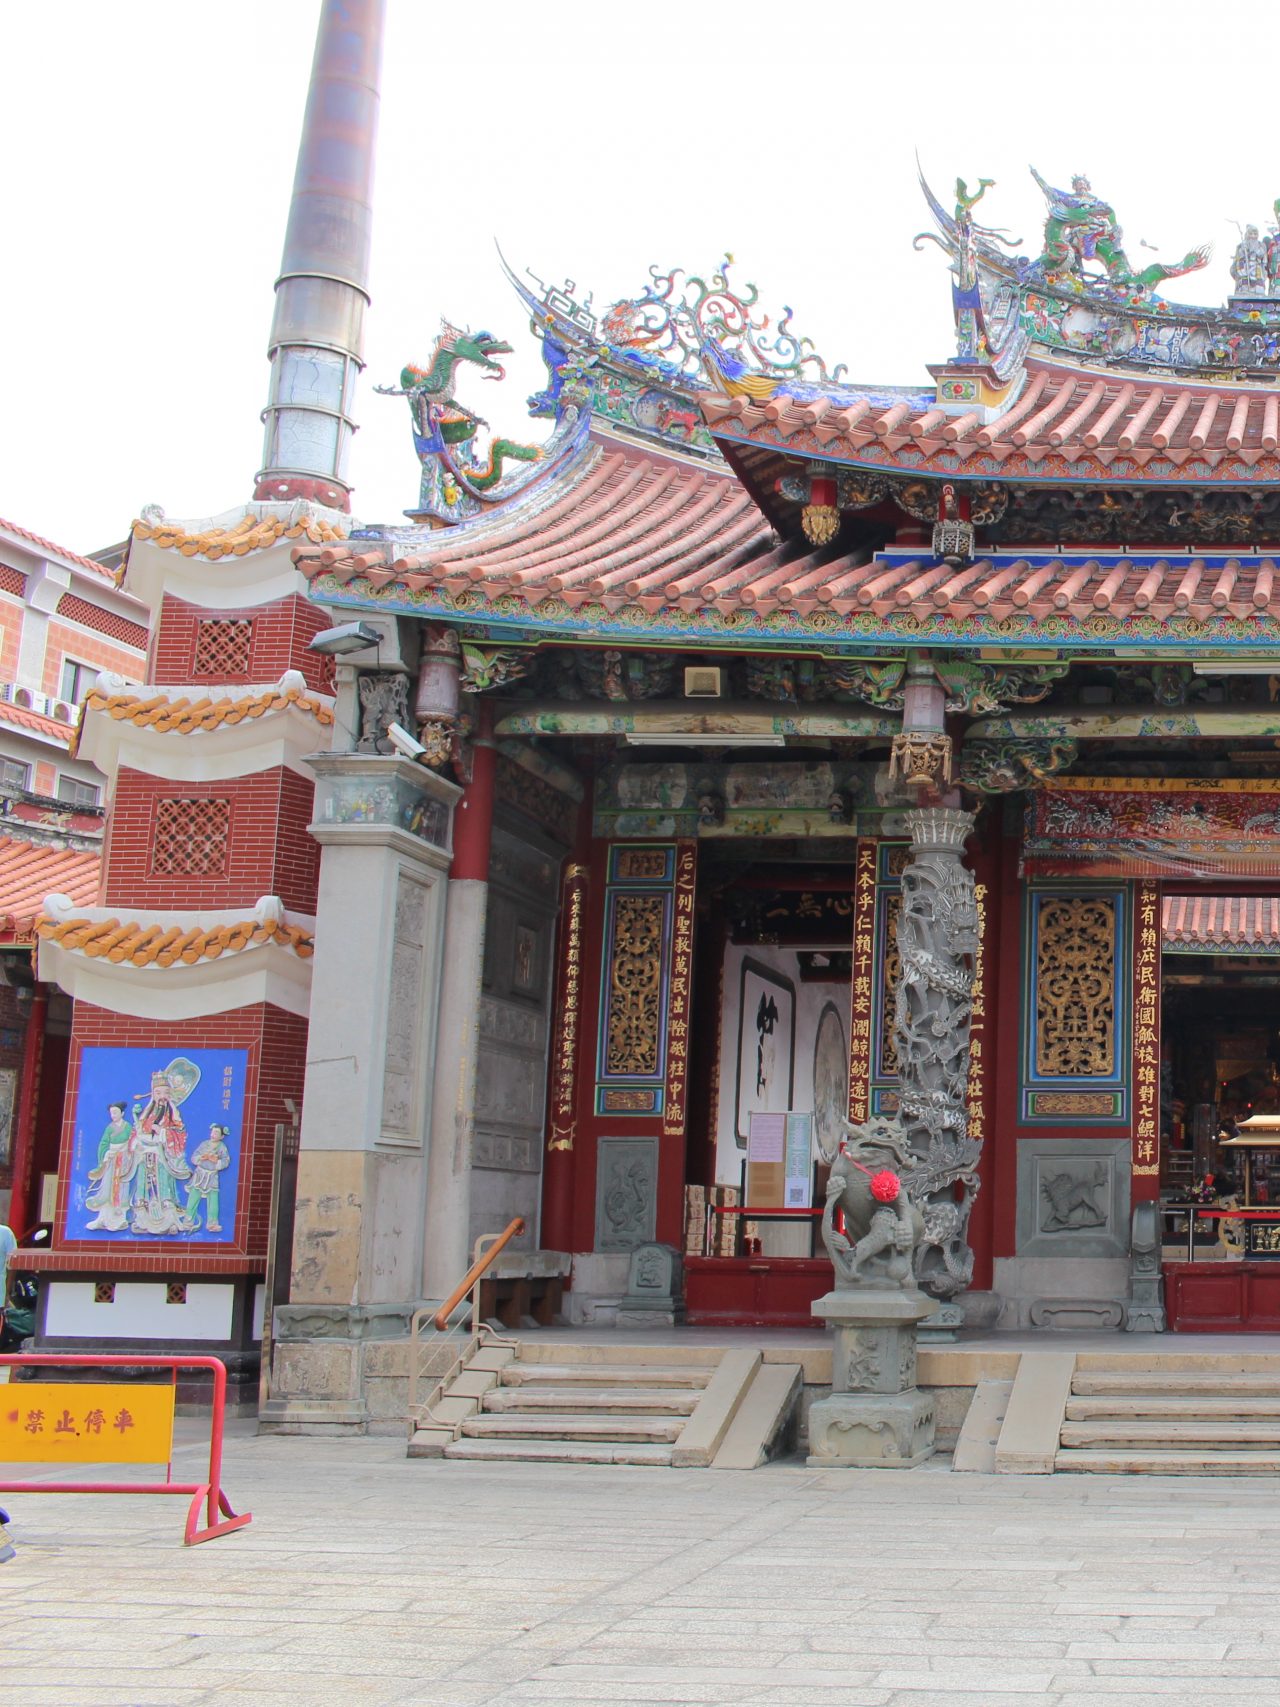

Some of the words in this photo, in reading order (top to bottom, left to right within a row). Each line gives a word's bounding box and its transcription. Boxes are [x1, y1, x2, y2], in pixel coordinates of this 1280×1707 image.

[849, 850, 876, 1122] 天本乎仁賴千載安瀾鯨鯢遠遁
[25, 1408, 135, 1435] 禁止停車
